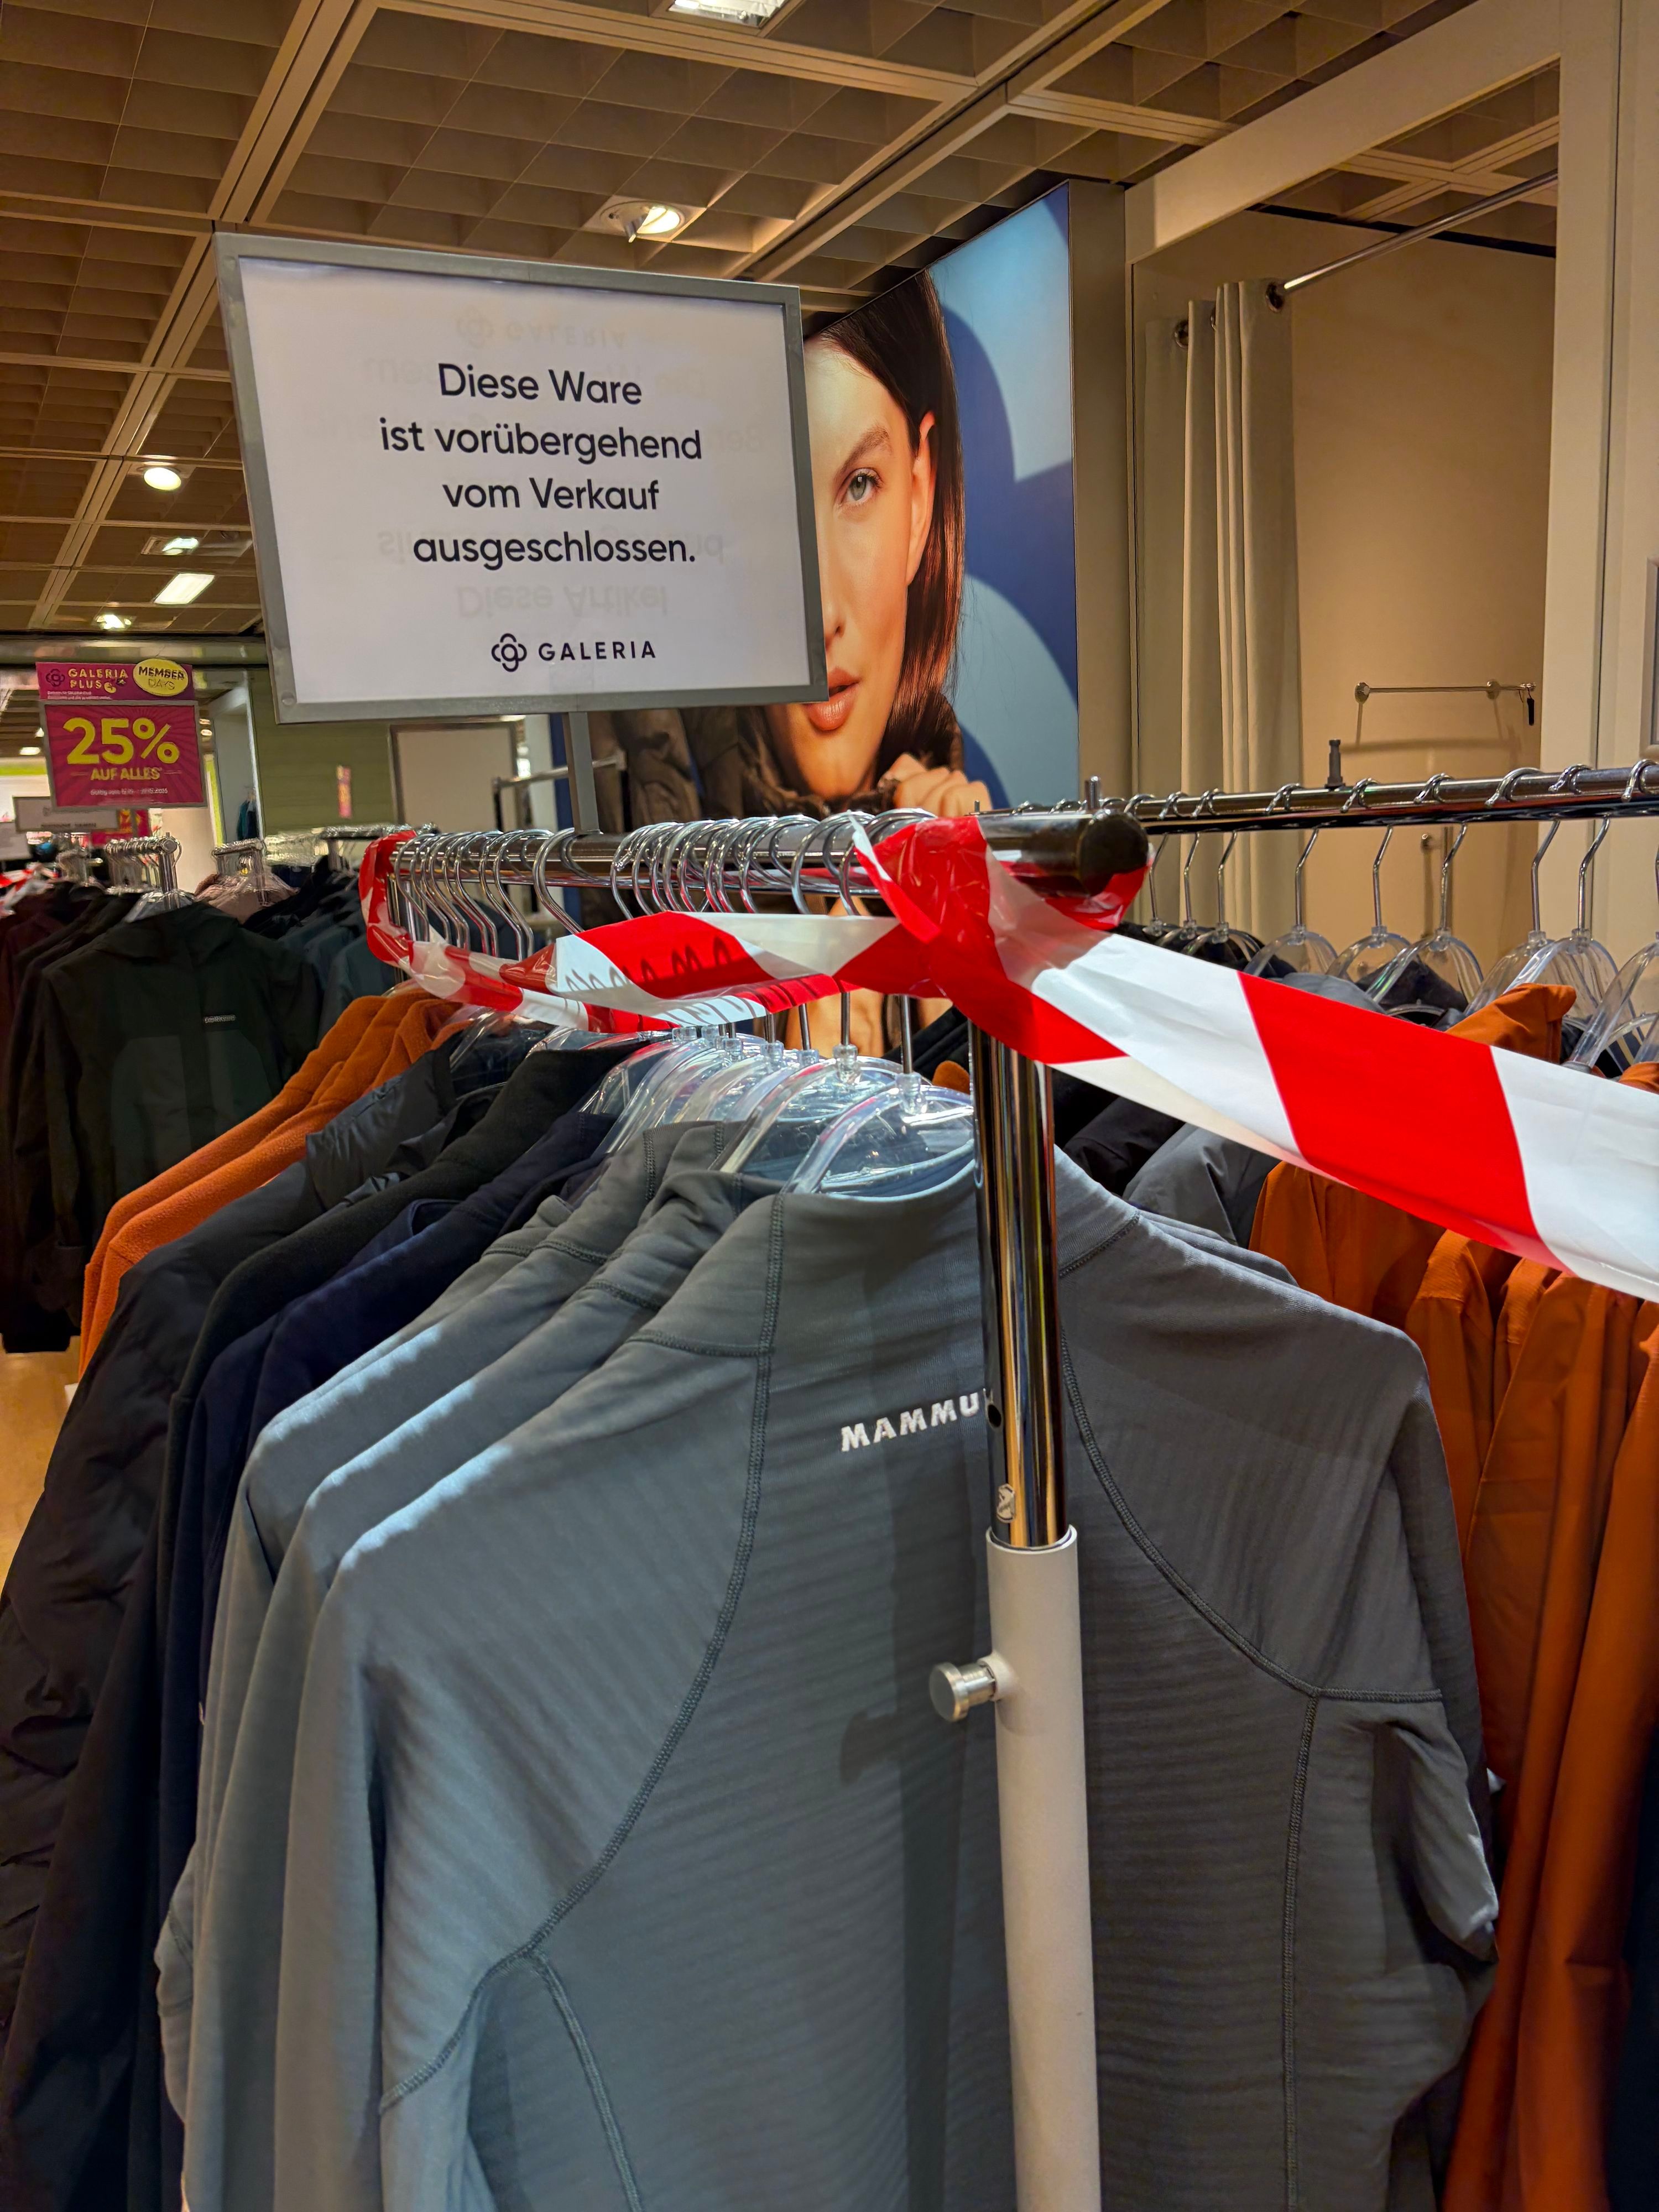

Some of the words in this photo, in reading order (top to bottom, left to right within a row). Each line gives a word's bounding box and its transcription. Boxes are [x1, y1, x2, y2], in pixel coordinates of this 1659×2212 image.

[438, 363, 539, 400] Diese
[548, 369, 642, 405] Ware
[379, 417, 425, 451] ist
[434, 422, 702, 465] vorübergehend
[442, 484, 520, 508] vom
[529, 477, 660, 510] Verkauf
[413, 530, 696, 571] ausgeschlossen.
[538, 640, 656, 661] GALERIA
[68, 668, 128, 679] GALERIA
[70, 680, 102, 689] PLUS
[138, 666, 185, 680] MEMBER
[148, 678, 175, 690] DAYS
[64, 718, 179, 764] 25%
[90, 768, 117, 780] AUF
[841, 1389, 984, 1452] MAMMU
